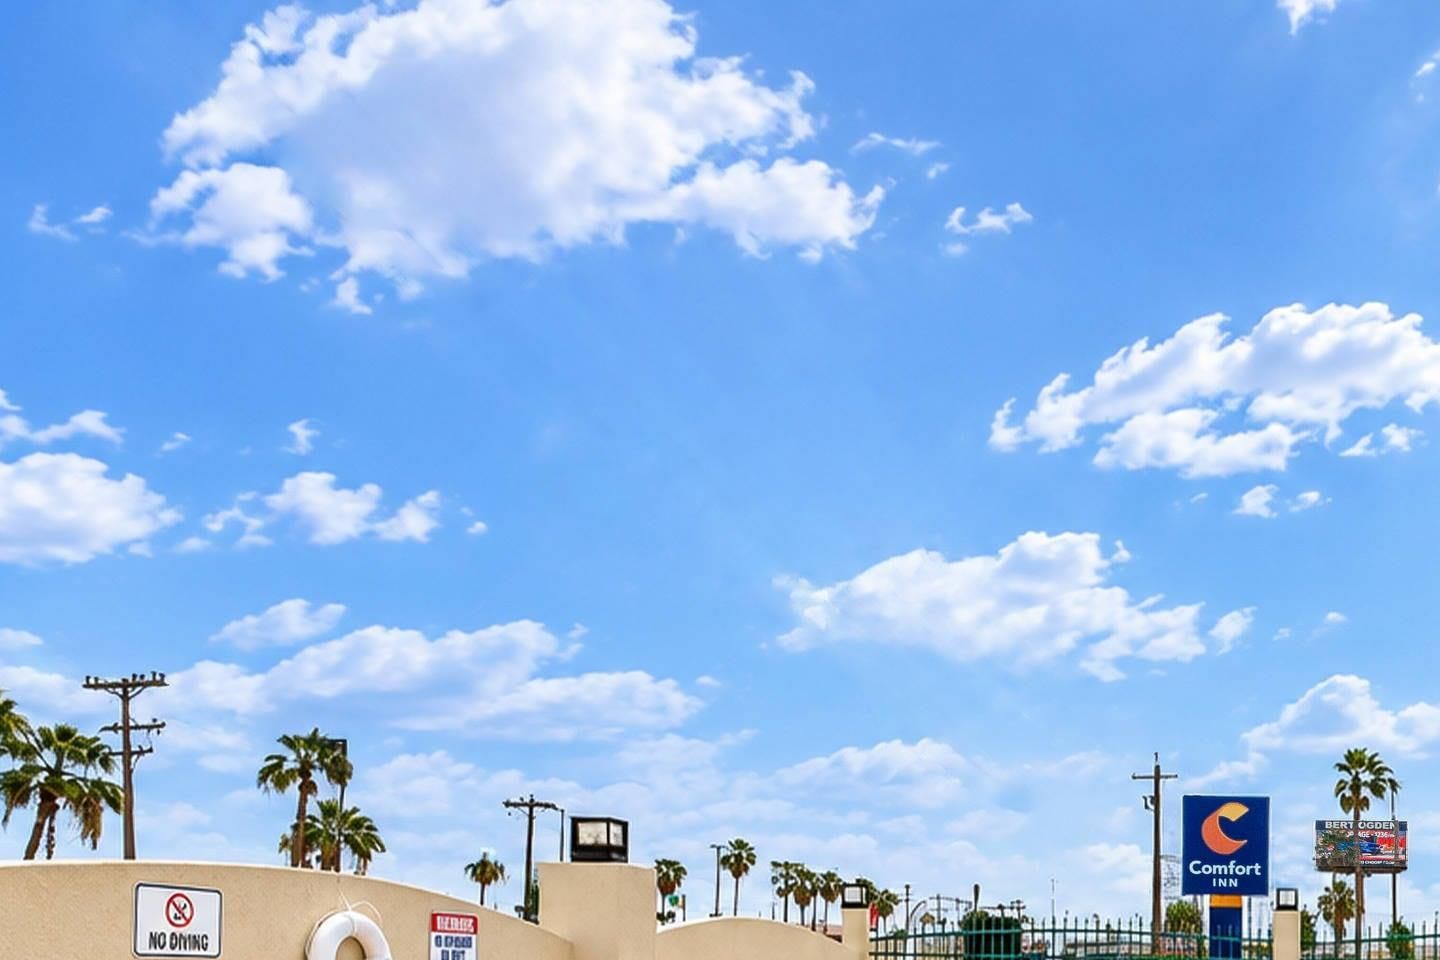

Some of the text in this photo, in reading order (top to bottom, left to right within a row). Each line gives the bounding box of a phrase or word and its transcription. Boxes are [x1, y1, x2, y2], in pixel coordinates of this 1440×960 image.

[1325, 821, 1395, 830] BERT OGDEN
[1189, 860, 1262, 876] Comfort
[1212, 878, 1238, 888] INN
[148, 931, 209, 952] NO DIVING
